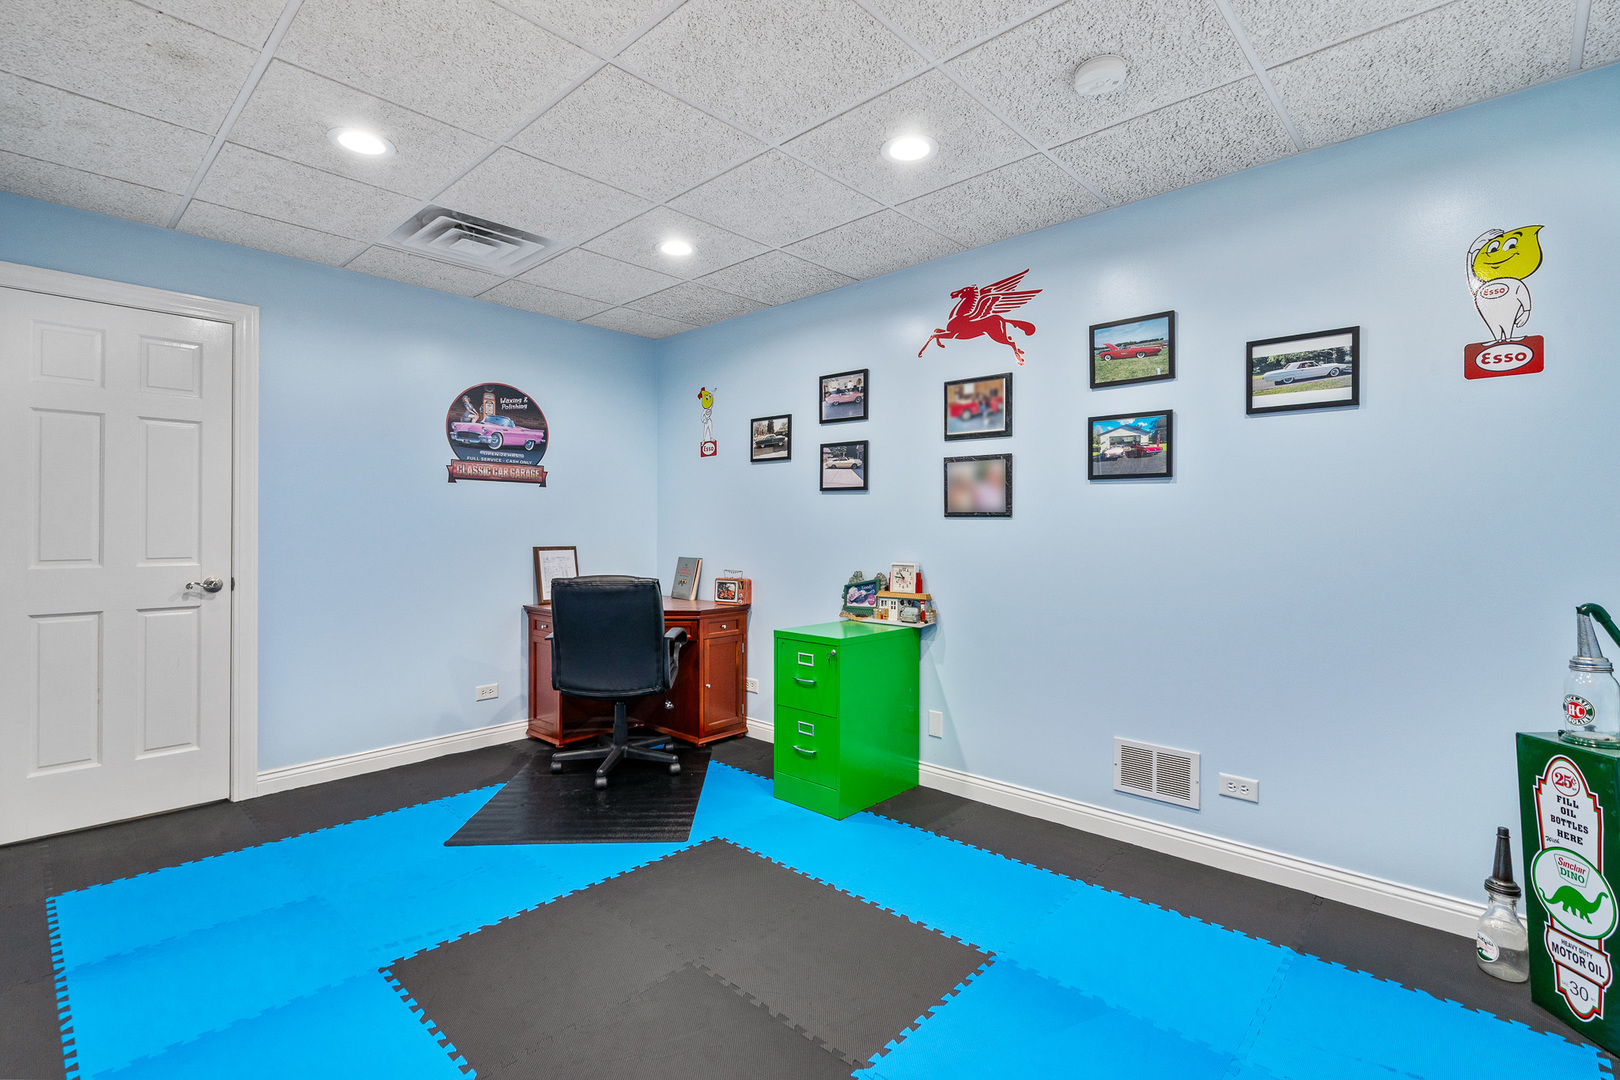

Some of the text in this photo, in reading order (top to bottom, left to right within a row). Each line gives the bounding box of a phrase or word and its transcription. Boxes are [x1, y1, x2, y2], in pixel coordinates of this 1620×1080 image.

[457, 464, 540, 479] CLASSIC CAR GARAGE
[1556, 795, 1579, 809] FILL
[1560, 806, 1577, 819] OIL
[1550, 814, 1589, 835] BOTTLES
[1556, 829, 1584, 846] HERE
[1557, 857, 1586, 875] Sinclair
[1560, 867, 1585, 884] DINO
[1560, 939, 1594, 960] HEAVY DUTY
[1551, 941, 1605, 979] MOTOR OIL
[1570, 980, 1588, 1001] 30
